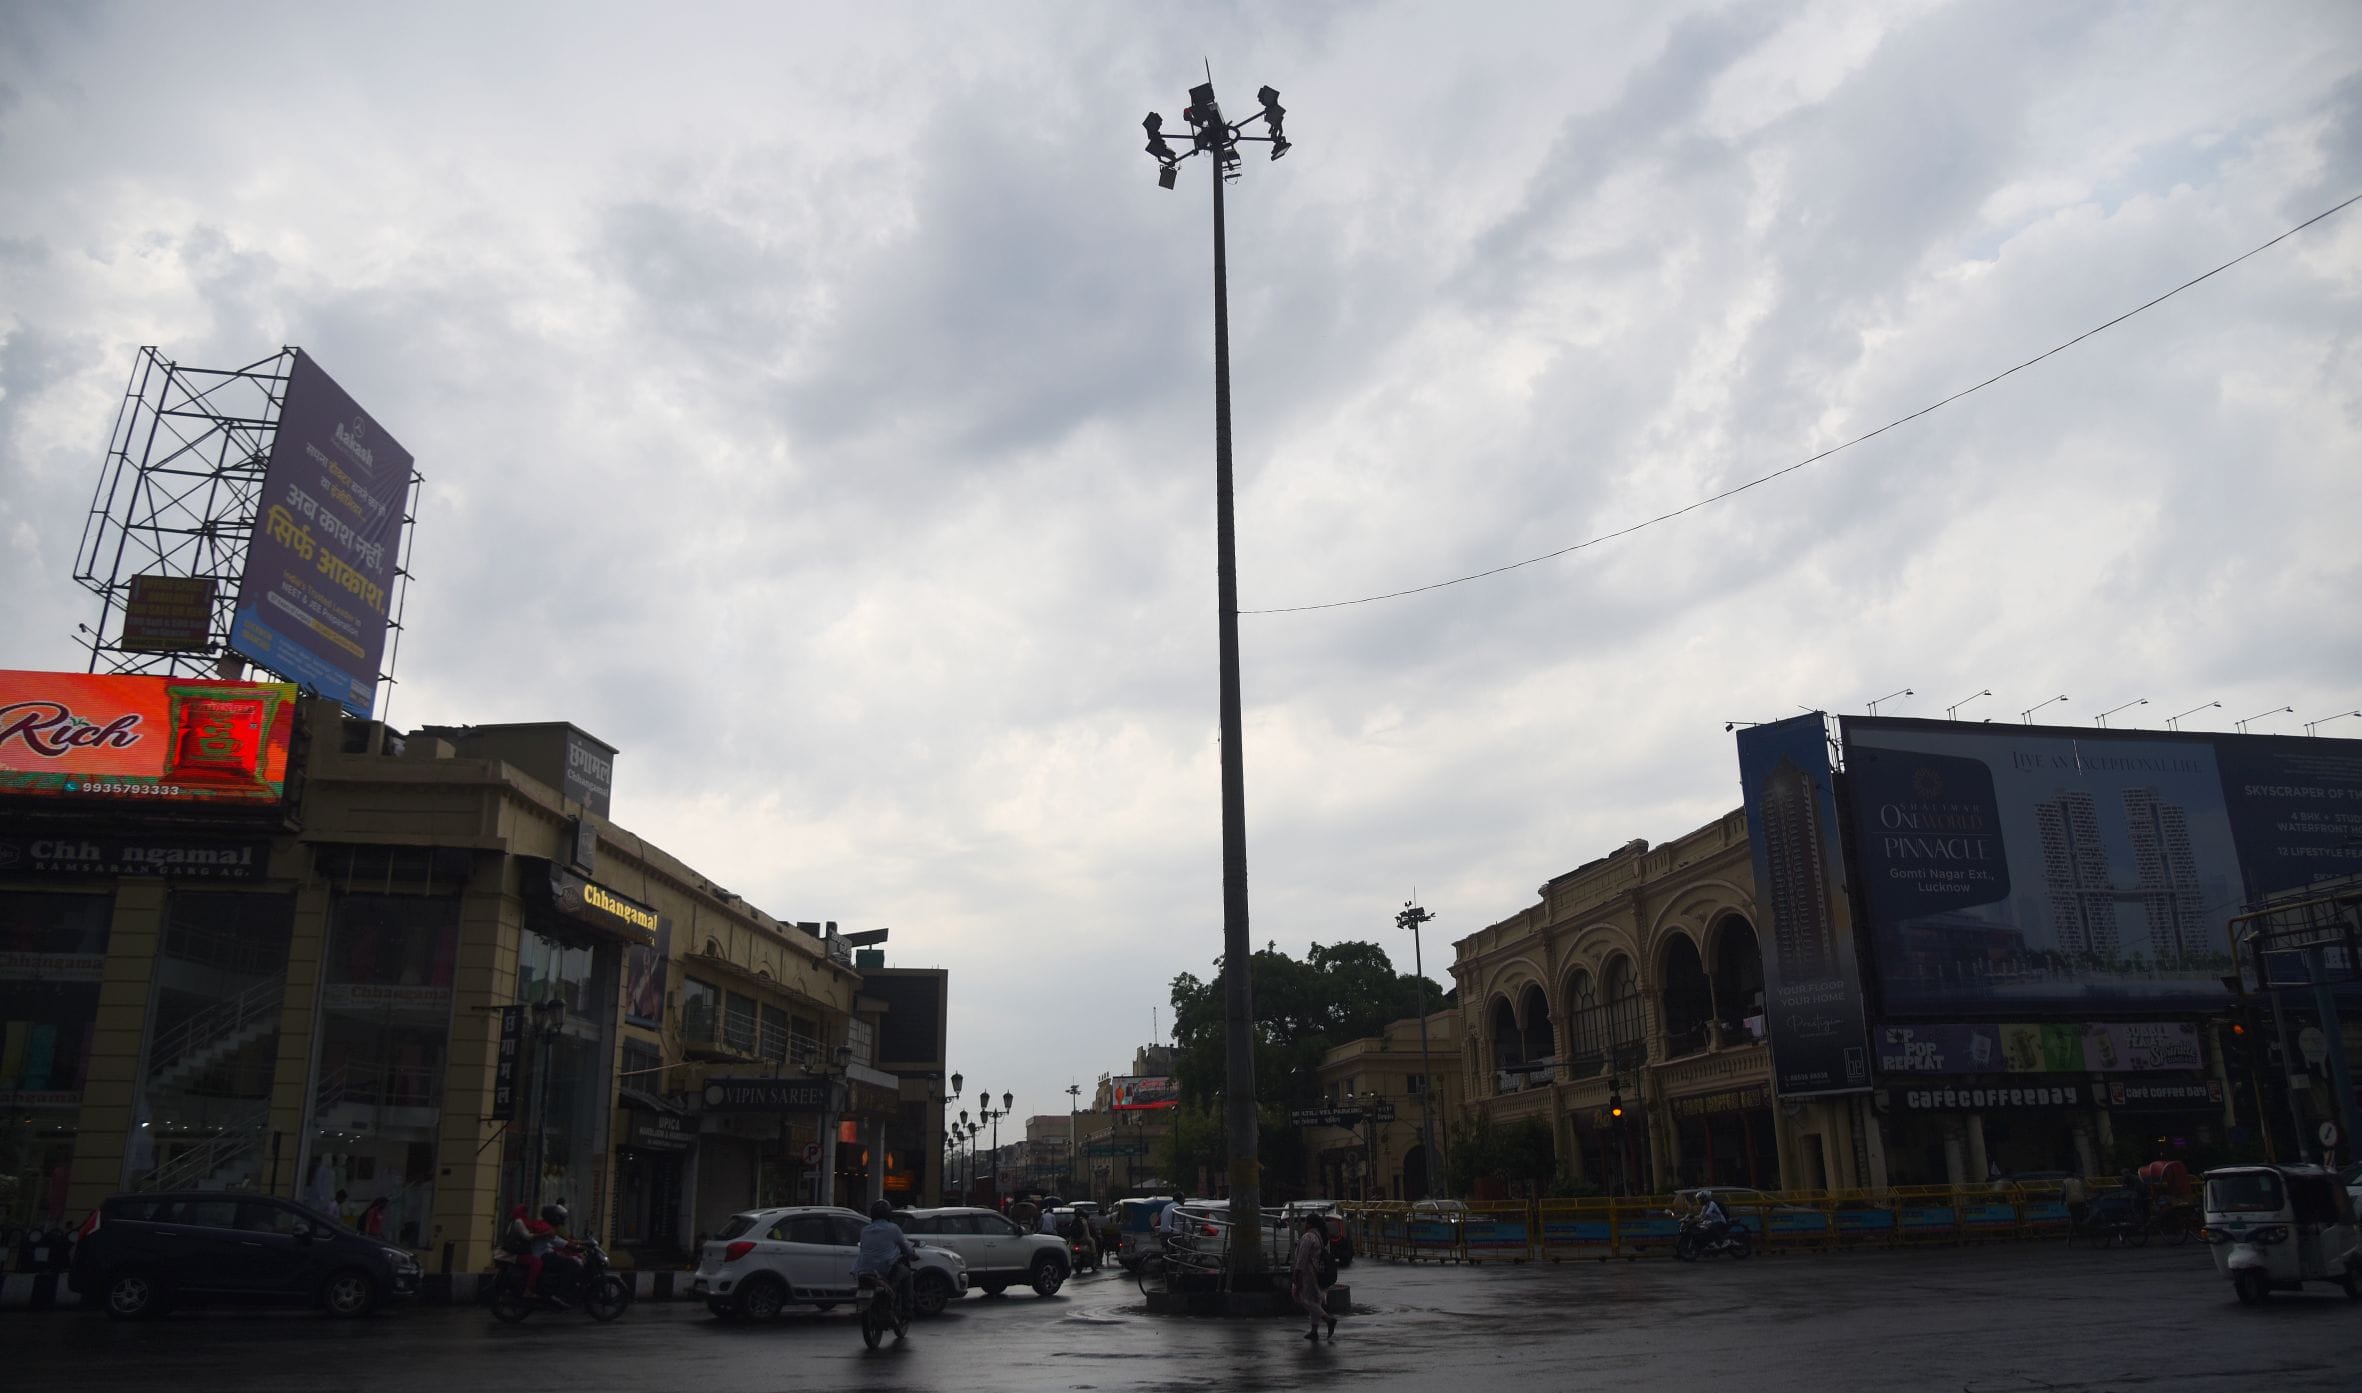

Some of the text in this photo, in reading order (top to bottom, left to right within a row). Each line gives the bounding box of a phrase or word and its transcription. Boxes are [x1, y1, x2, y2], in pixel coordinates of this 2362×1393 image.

[336, 422, 373, 467] Aakash
[286, 482, 319, 521] अब
[320, 507, 356, 550] काश
[265, 503, 317, 561] सिर्फ
[0, 701, 142, 757] Rich
[569, 741, 610, 785] छंगामल
[83, 784, 179, 795] 9935793333
[568, 769, 609, 798] Chhangamal
[2244, 785, 2326, 799] SKYSCRAPER
[2327, 788, 2344, 799] OF
[2277, 823, 2347, 833] WATERFRONT
[2278, 847, 2290, 857] 12
[2291, 848, 2343, 858] LIFESTYLE
[1889, 868, 1926, 879] Gomti
[1930, 870, 1965, 881] Nagar
[1918, 881, 1970, 892] Lucknow
[584, 883, 658, 932] Chhangamal
[1777, 980, 1846, 996] YOUR FLOOR
[1780, 991, 1847, 1008] YOUR HOME
[1904, 1042, 1937, 1056] POP
[1882, 1055, 1945, 1071] REPEAT
[726, 1087, 768, 1105] VIPIN
